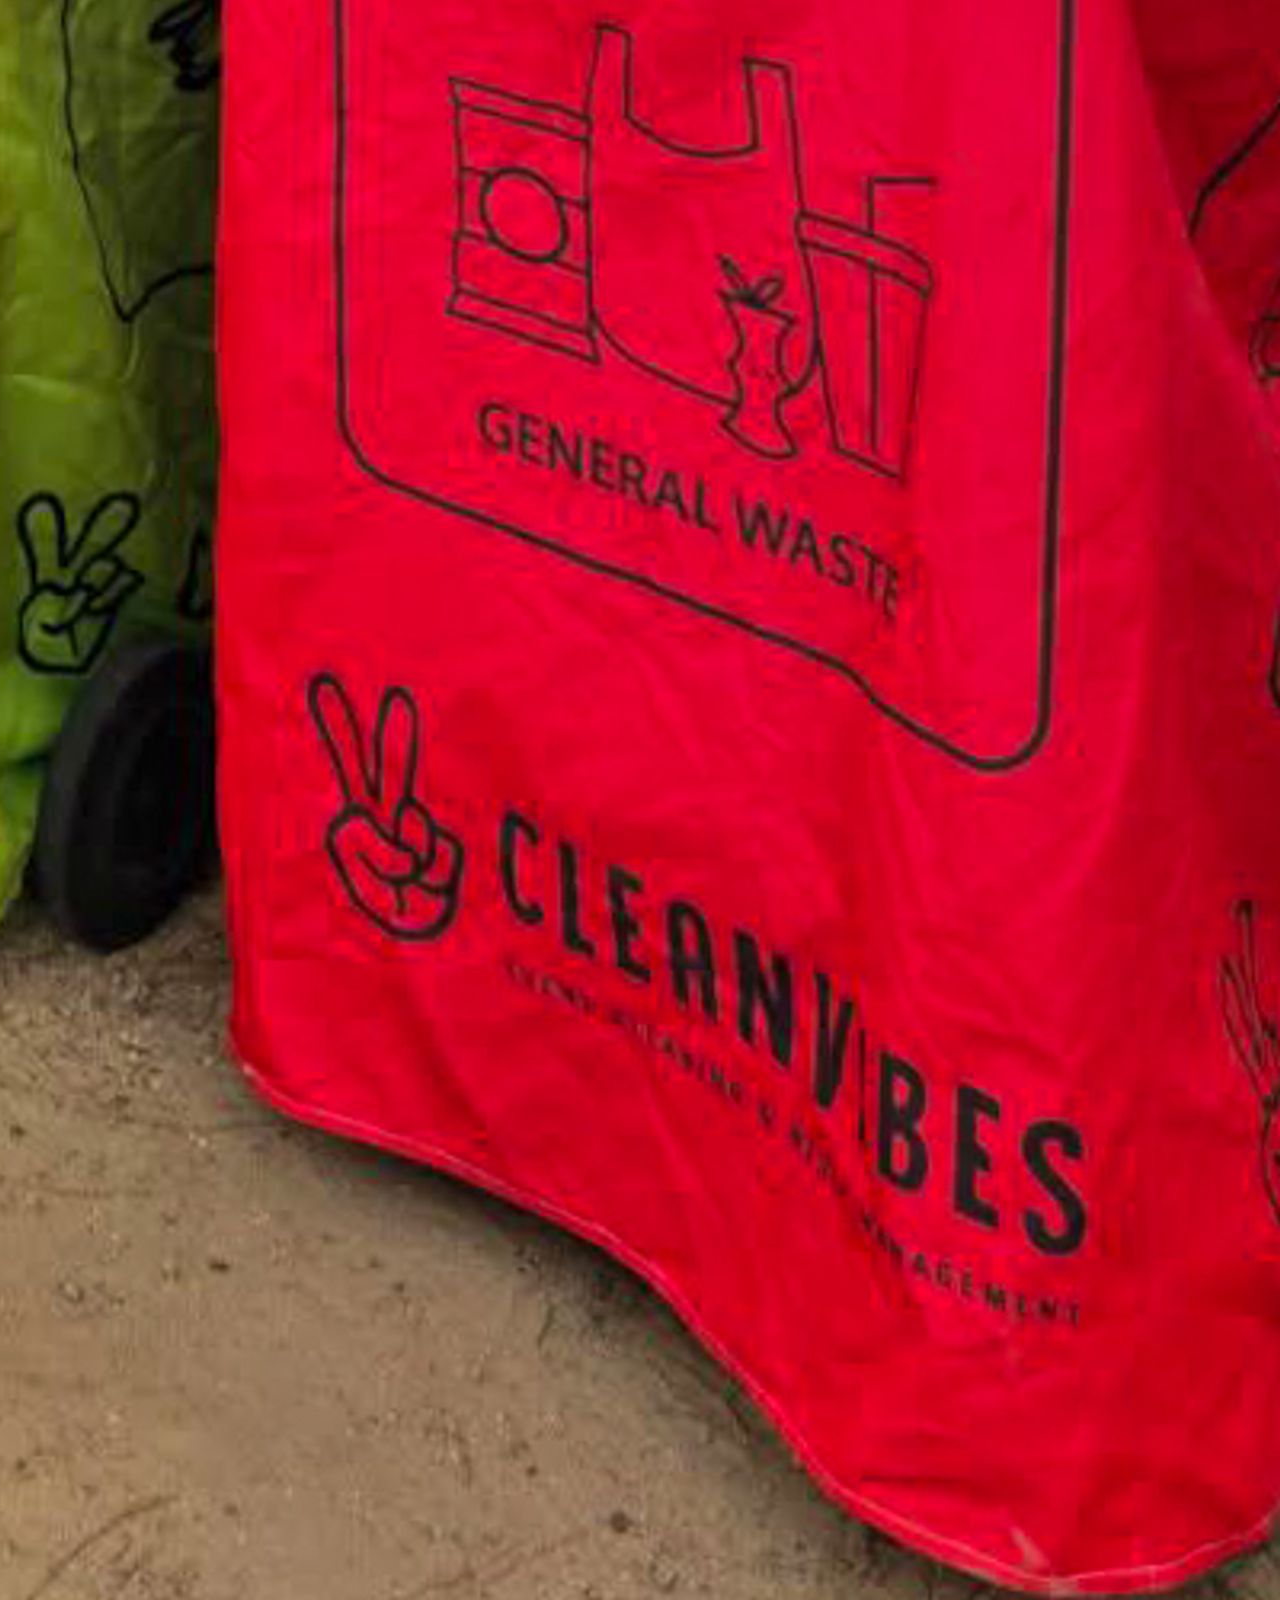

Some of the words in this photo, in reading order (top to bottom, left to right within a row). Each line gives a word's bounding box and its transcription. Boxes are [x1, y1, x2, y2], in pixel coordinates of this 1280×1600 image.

[476, 401, 721, 535] GENERAL
[735, 493, 900, 622] WASTE
[499, 808, 1089, 1257] CLEANVIBES
